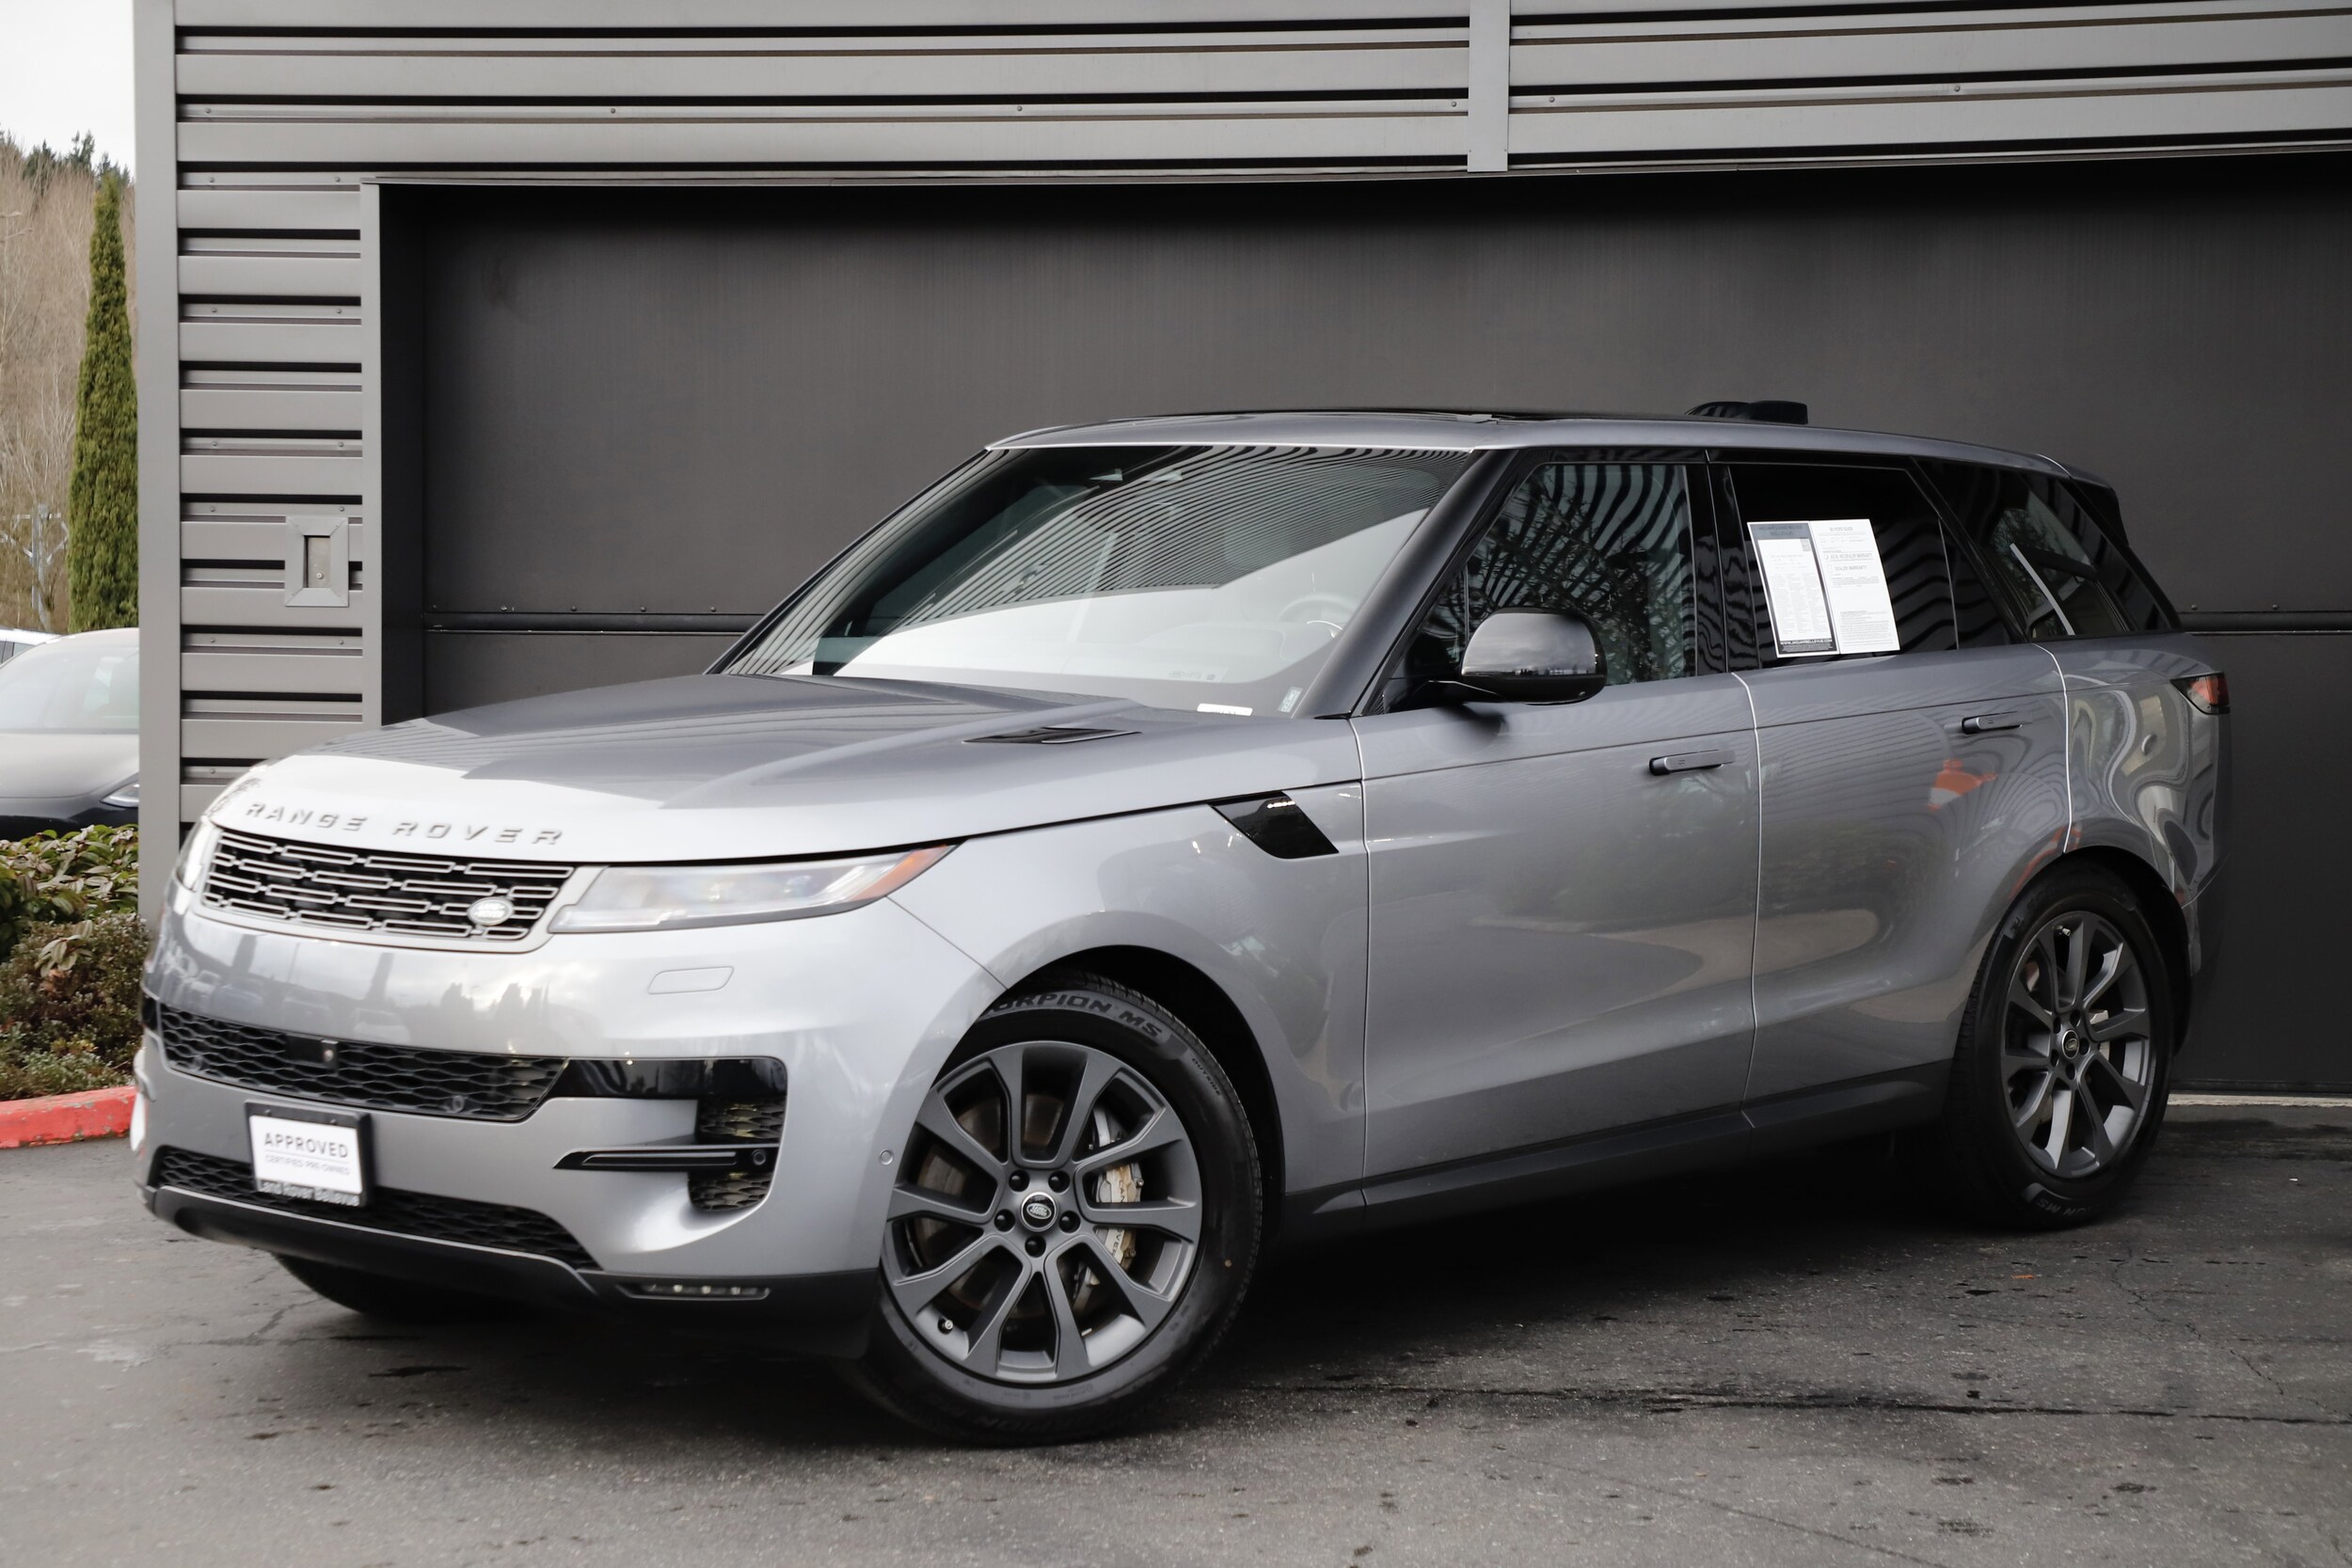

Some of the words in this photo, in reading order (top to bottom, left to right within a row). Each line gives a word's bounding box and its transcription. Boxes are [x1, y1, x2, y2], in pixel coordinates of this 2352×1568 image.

[246, 802, 368, 832] RANGE
[391, 821, 563, 846] ROVER
[993, 993, 1113, 1014] ORPION
[1119, 1009, 1163, 1038] MS
[264, 1132, 348, 1159] APPROVED
